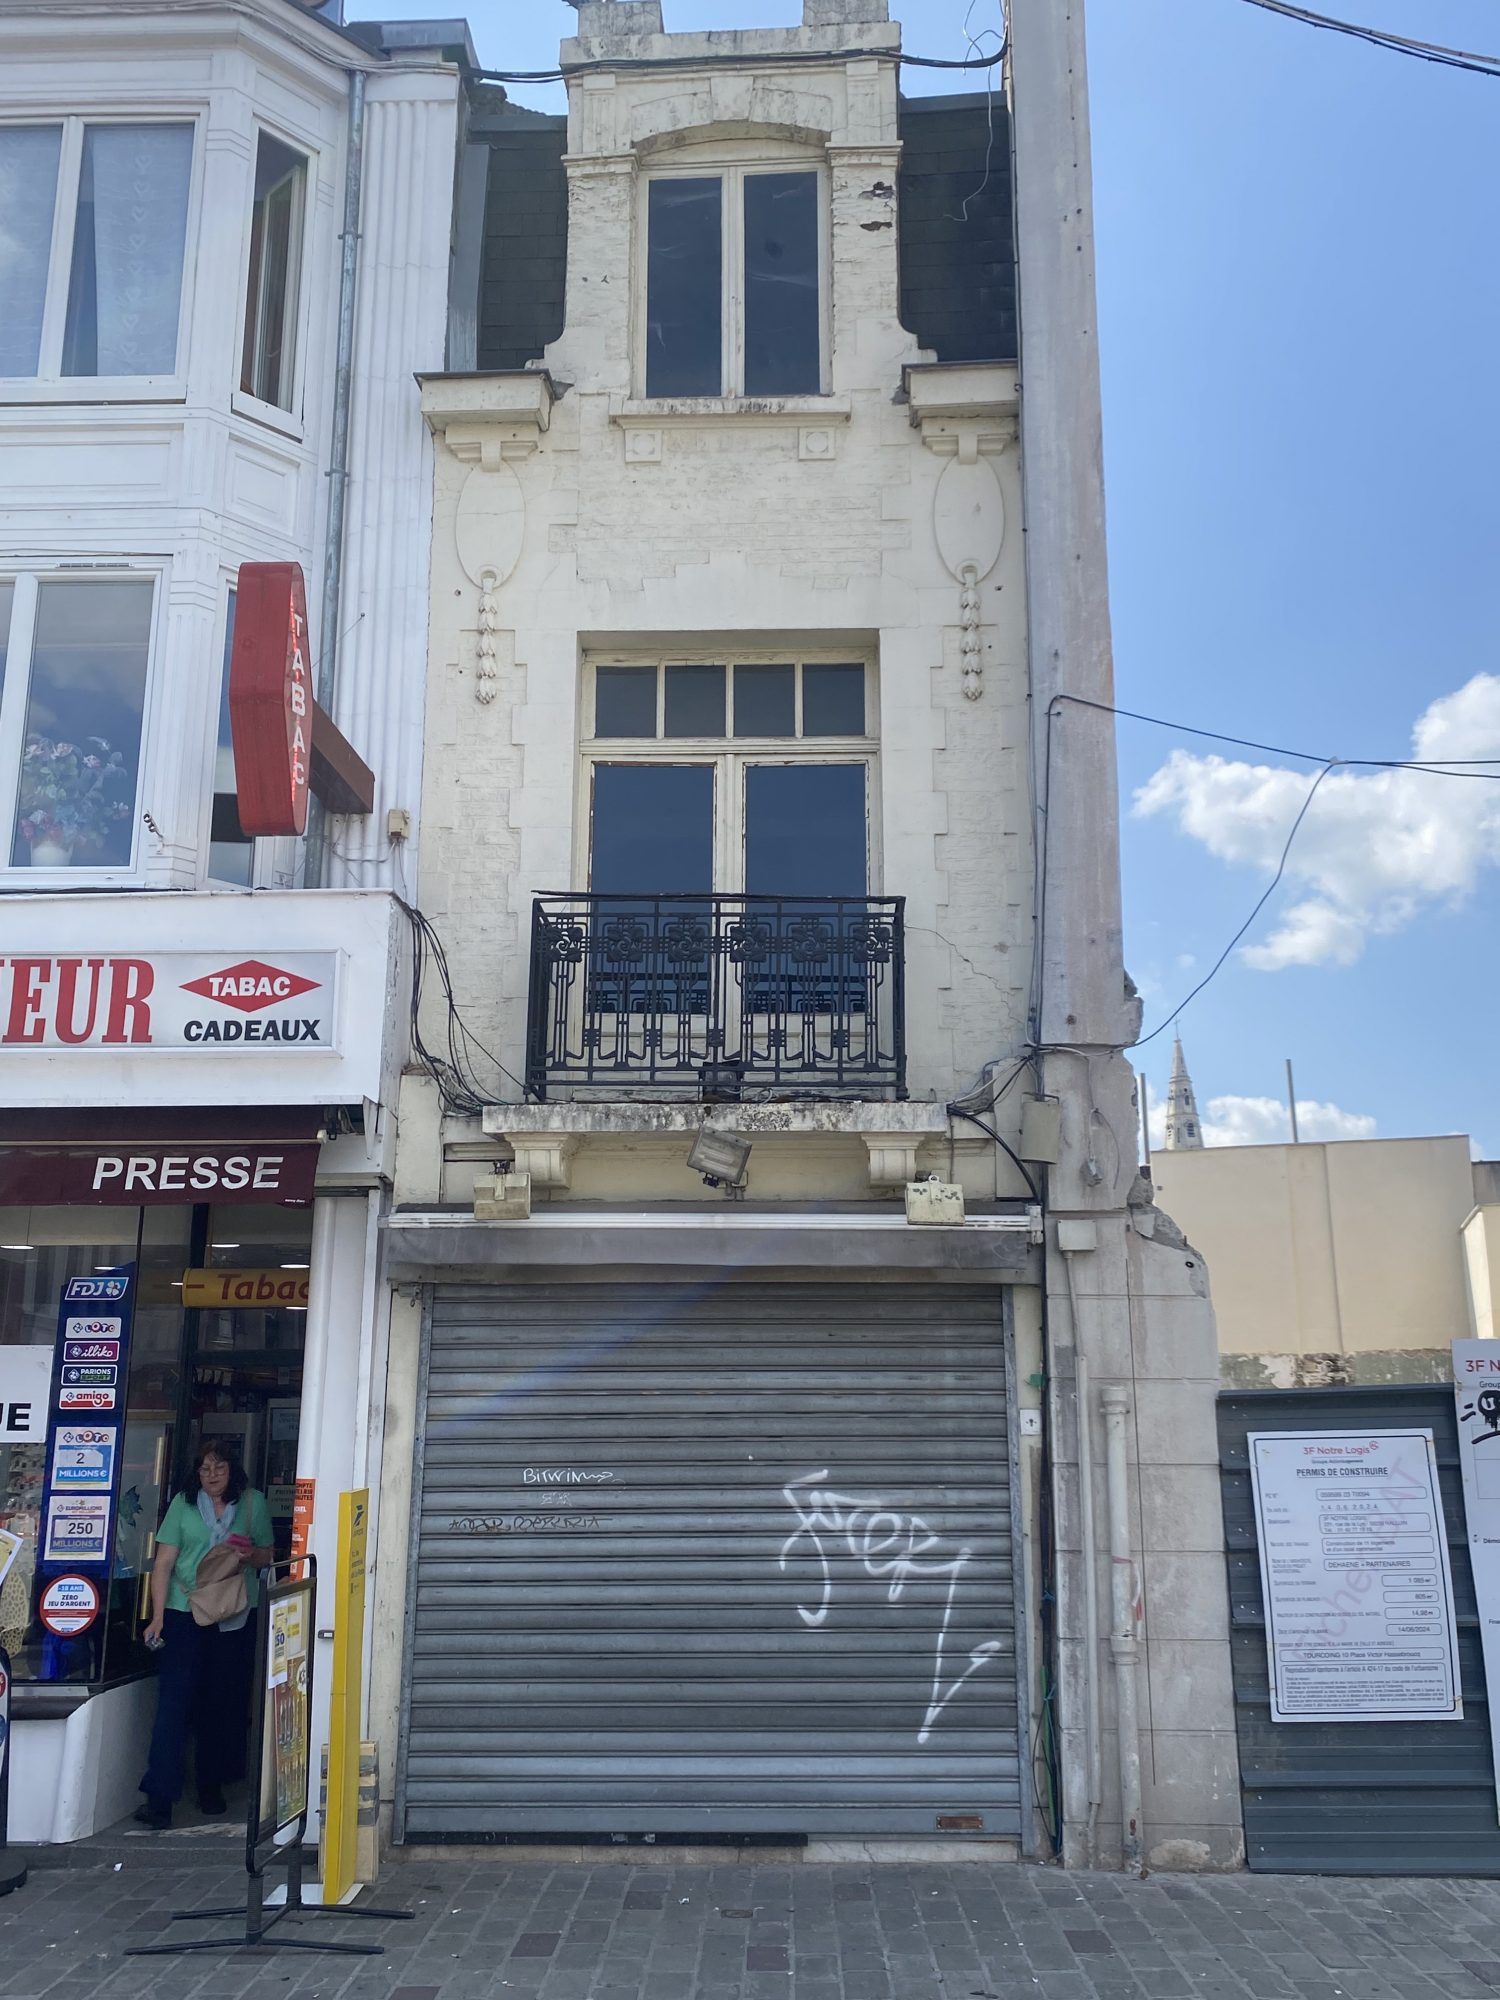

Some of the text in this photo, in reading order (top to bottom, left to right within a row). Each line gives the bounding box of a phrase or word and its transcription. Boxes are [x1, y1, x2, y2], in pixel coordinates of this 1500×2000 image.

[291, 612, 306, 785] TABAC
[209, 976, 291, 997] TABAC
[0, 959, 154, 1043] EUR
[183, 1019, 320, 1041] CADEAUX
[92, 1156, 284, 1190] PRESSE
[70, 1281, 104, 1296] FDJ
[85, 1321, 115, 1333] LOTO
[81, 1345, 113, 1357] illiko
[1465, 1360, 1485, 1372] 3F
[76, 1391, 109, 1405] amigo
[0, 1403, 31, 1431] E
[75, 1430, 109, 1443] LOTO
[1303, 1446, 1370, 1457] 3F Notre Logis
[76, 1453, 85, 1465] 2
[58, 1470, 99, 1478] MILLIONS
[1296, 1467, 1389, 1476] PERMIS DE CONSTRUIRE
[67, 1522, 93, 1535] 250
[52, 1540, 94, 1548] MILLIONS
[1366, 1560, 1411, 1568] PARTENAIRES
